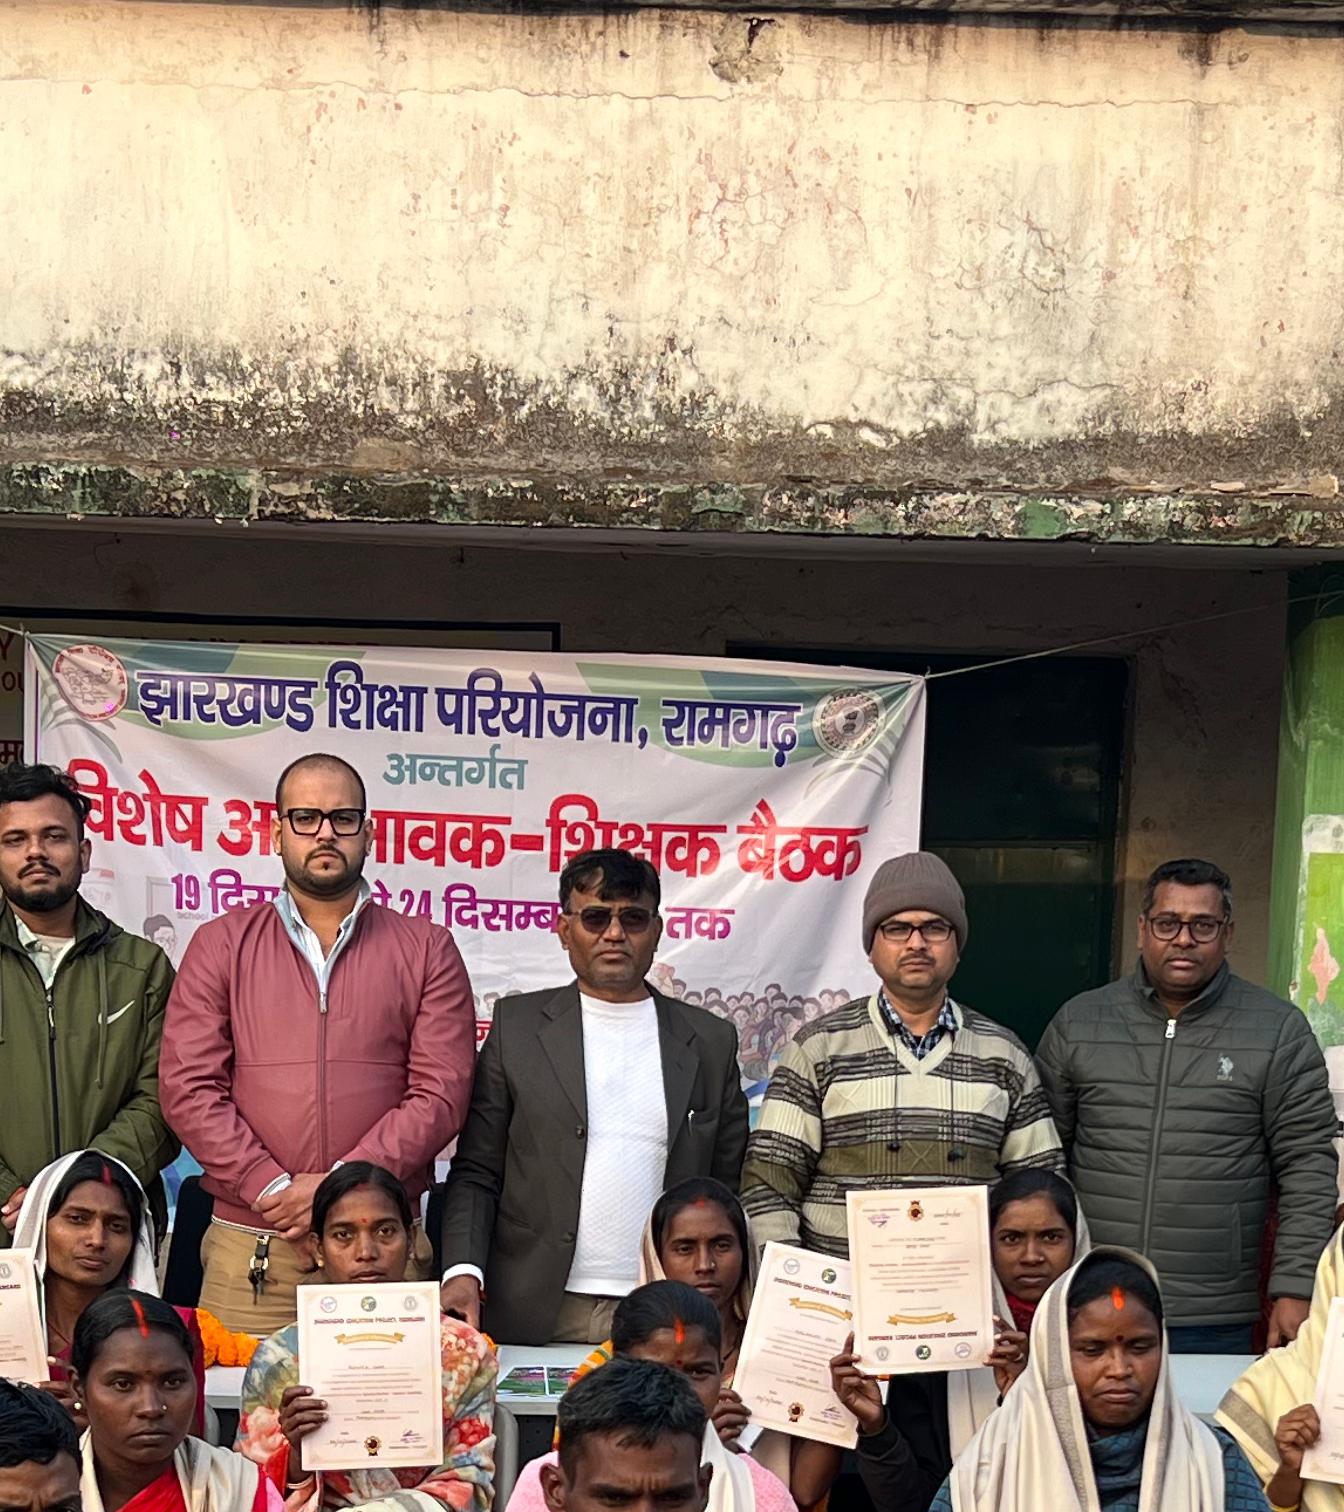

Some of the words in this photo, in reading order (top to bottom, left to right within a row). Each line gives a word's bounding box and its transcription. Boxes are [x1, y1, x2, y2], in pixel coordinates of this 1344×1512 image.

[136, 670, 319, 735] झारखण्ड
[324, 660, 427, 733] शिक्षा
[434, 668, 649, 750] परियोजना,
[661, 698, 802, 768] रामगढ़
[382, 744, 529, 791] अन्तर्गत
[66, 757, 209, 852] विशेष
[736, 798, 869, 883] बैठक
[170, 873, 201, 910] 19
[442, 882, 562, 933] दिसम्ब
[664, 905, 736, 941] तक
